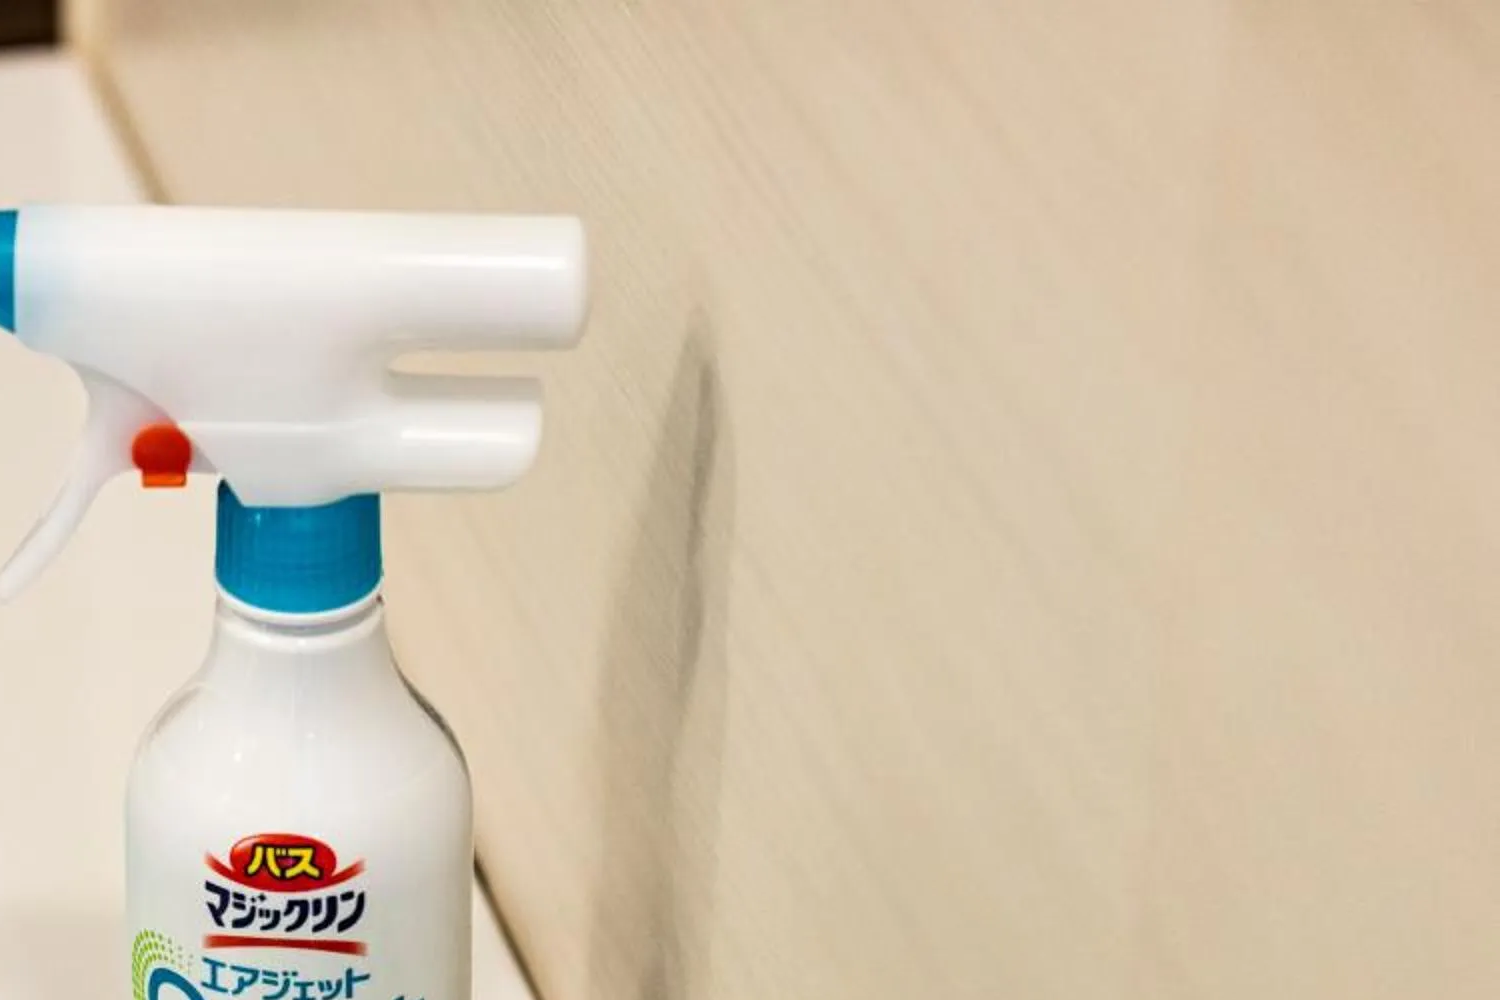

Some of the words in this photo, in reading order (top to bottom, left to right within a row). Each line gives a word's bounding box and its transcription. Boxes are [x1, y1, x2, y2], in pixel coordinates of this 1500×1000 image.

[246, 845, 321, 880] バス
[204, 880, 366, 933] マジックリン
